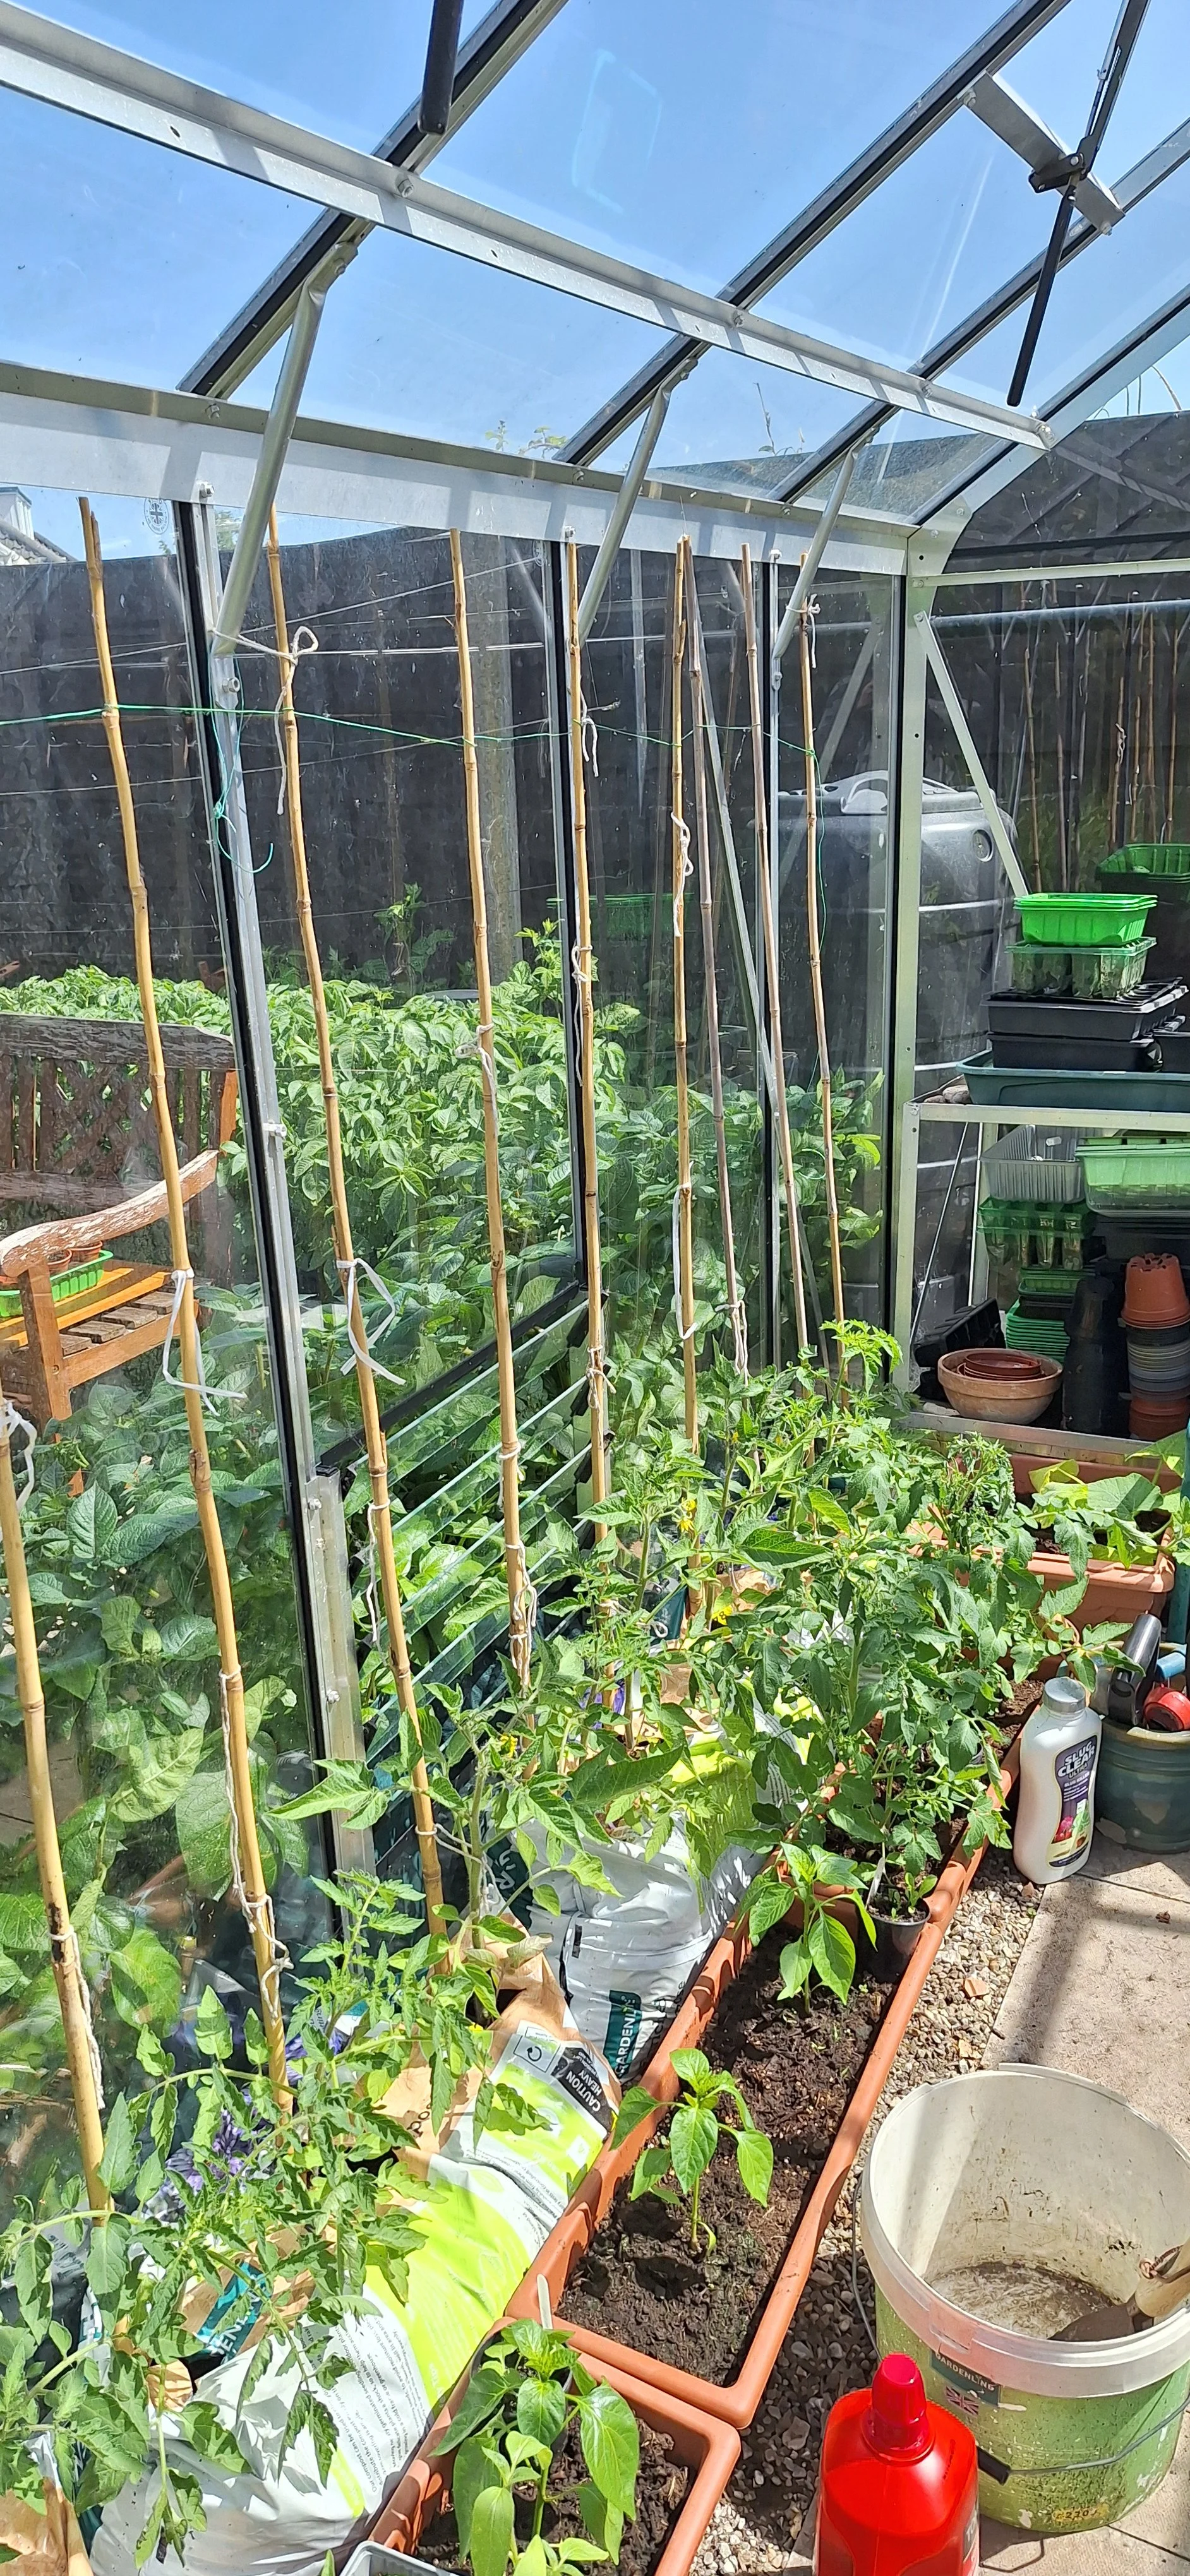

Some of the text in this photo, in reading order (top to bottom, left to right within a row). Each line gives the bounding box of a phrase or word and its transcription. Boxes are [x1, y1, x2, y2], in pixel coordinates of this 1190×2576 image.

[1057, 1746, 1095, 1777] CLEAR
[1064, 1741, 1092, 1766] SLUG
[1069, 1763, 1088, 1779] ULTRA
[577, 2069, 603, 2095] HEAVY
[565, 2072, 601, 2112] CAUTION
[375, 2319, 385, 2331] and
[382, 2330, 392, 2343] area
[380, 2342, 395, 2366] moisture
[359, 2359, 368, 2372] help
[366, 2352, 385, 2384] greenhouse
[392, 2366, 403, 2382] avoid
[335, 2392, 342, 2401] on
[371, 2384, 384, 2404] shock,
[365, 2394, 387, 2428] germinated
[383, 2407, 395, 2426] plants
[392, 2408, 402, 2422] cold
[338, 2418, 349, 2433] used
[349, 2419, 366, 2446] compost
[346, 2433, 354, 2442] be
[351, 2441, 359, 2453] can
[363, 2445, 371, 2457] the
[356, 2452, 371, 2479] compost
[368, 2456, 384, 2486] distribute
[368, 2479, 378, 2493] Our
